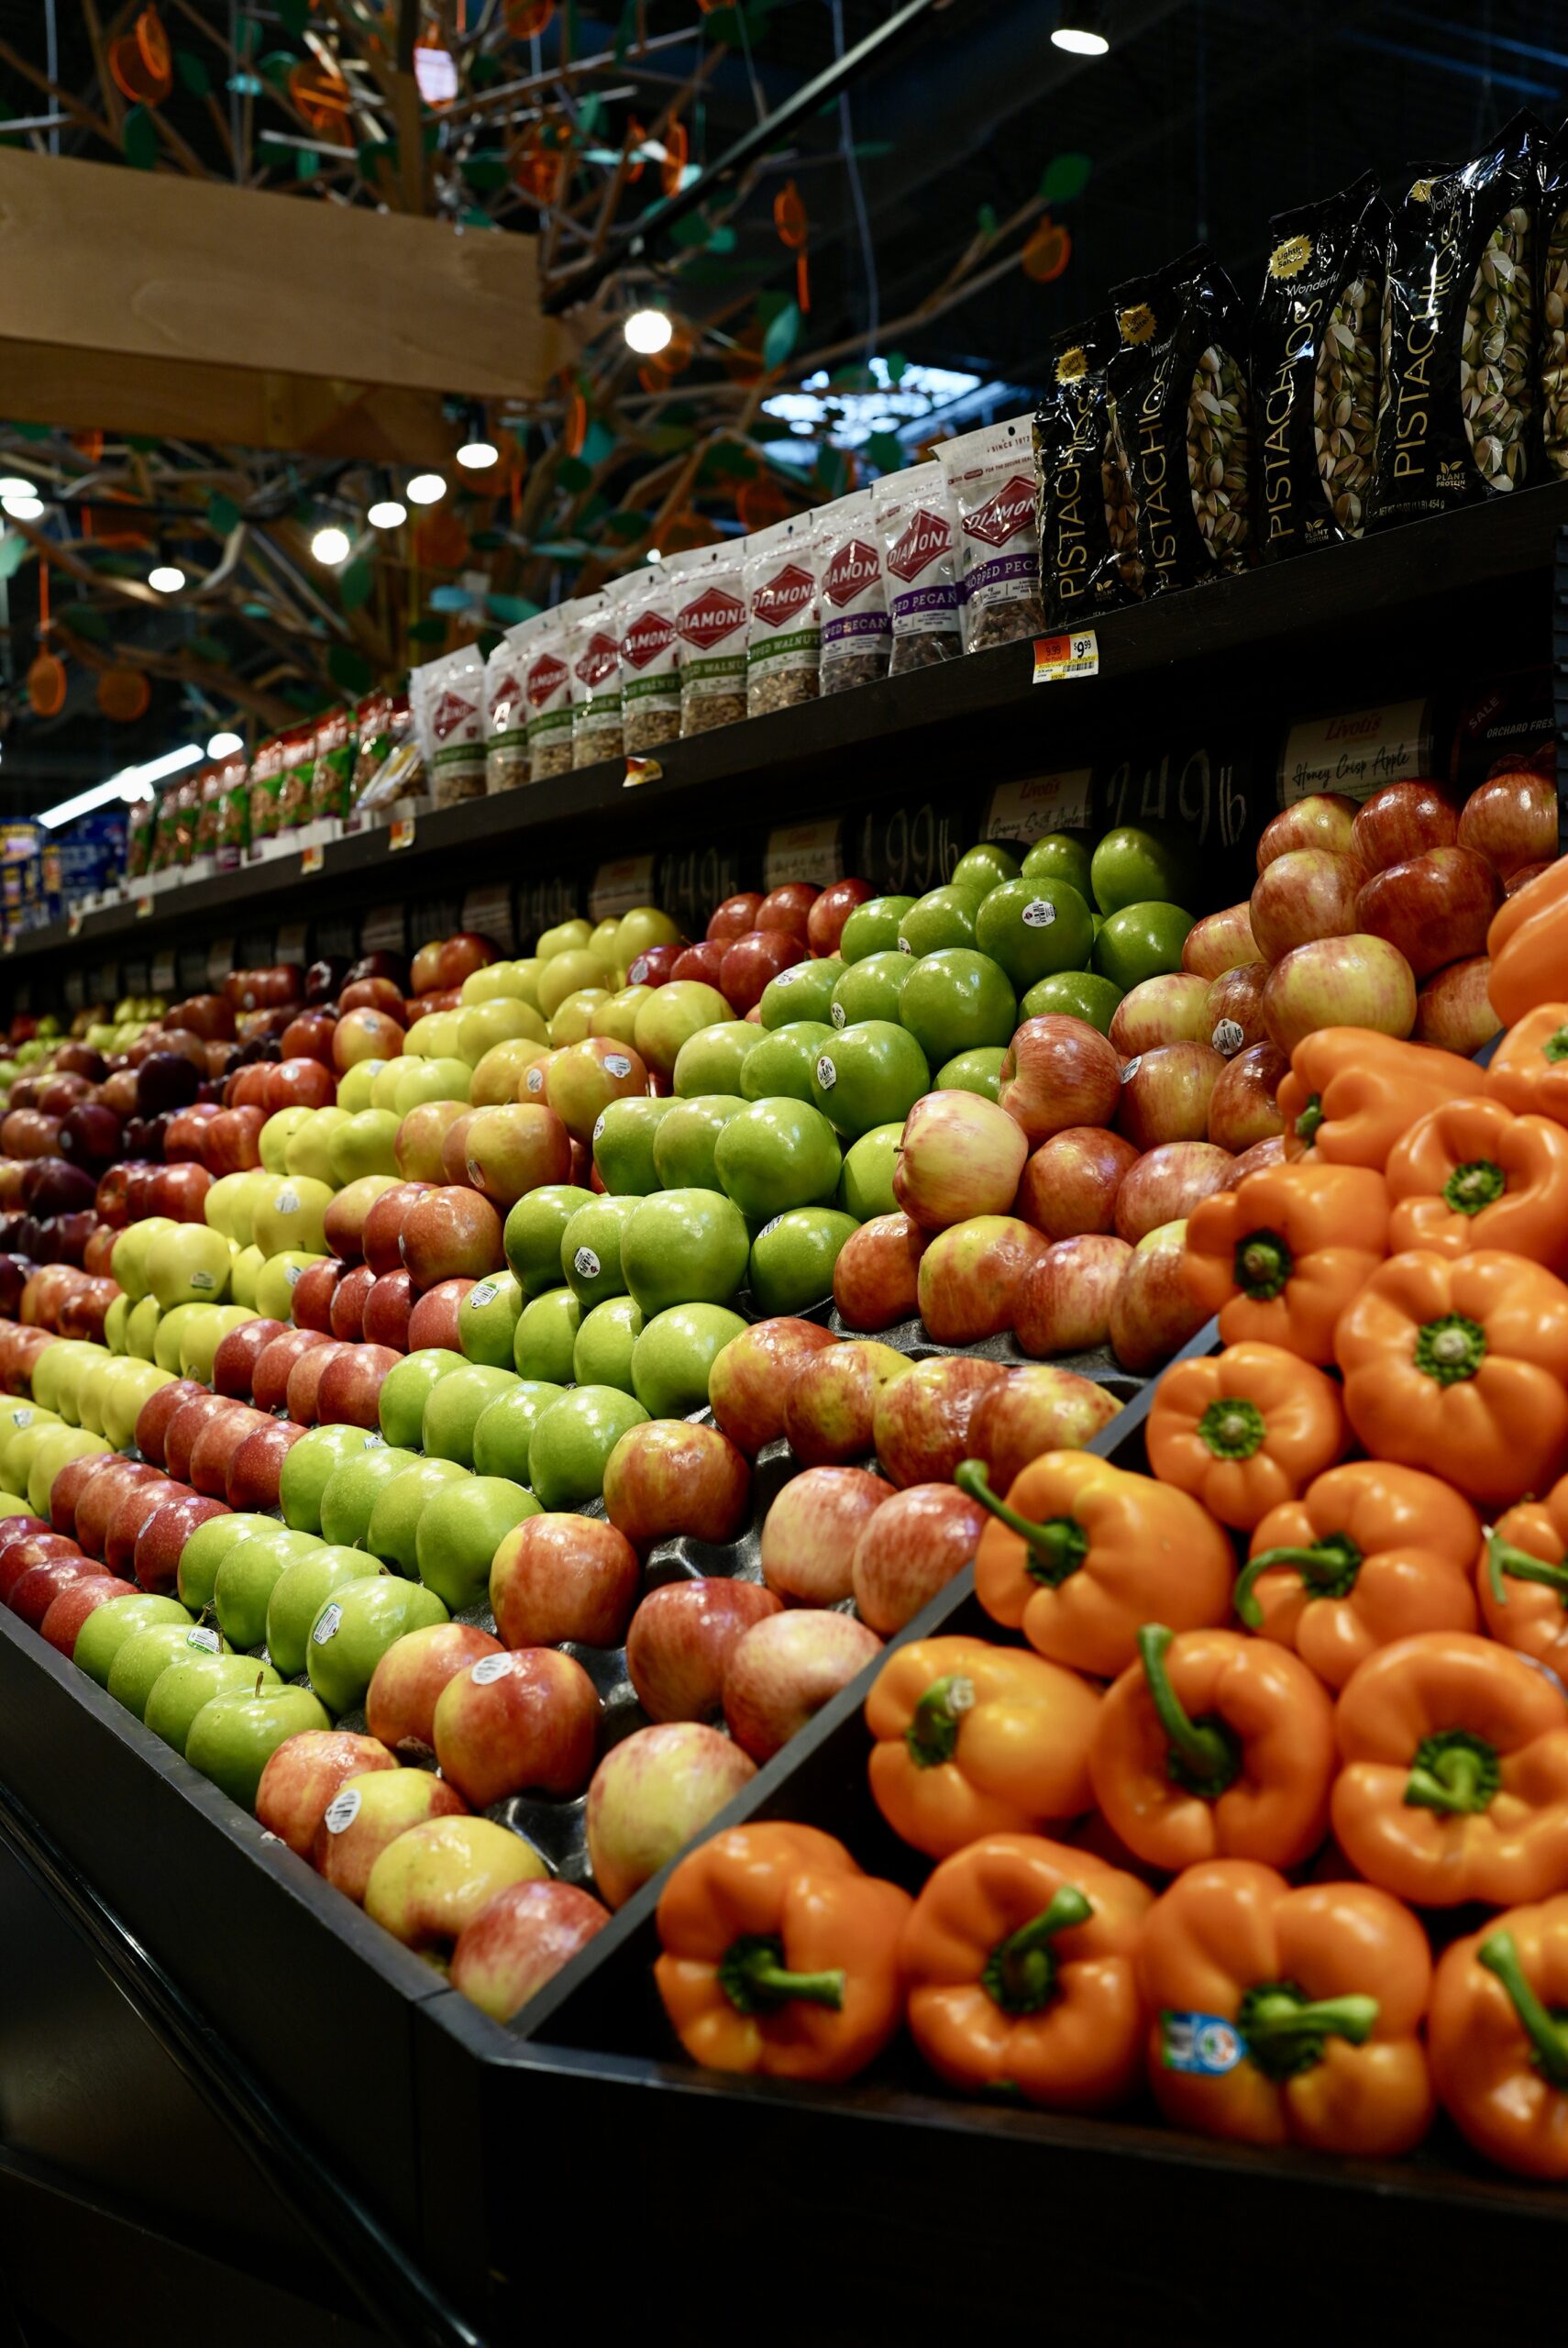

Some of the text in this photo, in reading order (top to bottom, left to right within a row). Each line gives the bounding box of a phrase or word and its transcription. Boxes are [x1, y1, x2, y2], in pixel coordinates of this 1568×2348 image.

[1286, 271, 1340, 297] Wonderfu
[1264, 297, 1323, 538] PISTACHIOS
[1436, 471, 1466, 482] PLANT
[968, 496, 1037, 531] DIAMON
[1467, 695, 1501, 730] SALE
[1486, 716, 1556, 740] ORCHARD FRES
[1291, 760, 1332, 792] Honey
[1335, 753, 1367, 781] Crisp
[1371, 742, 1411, 777] Apple
